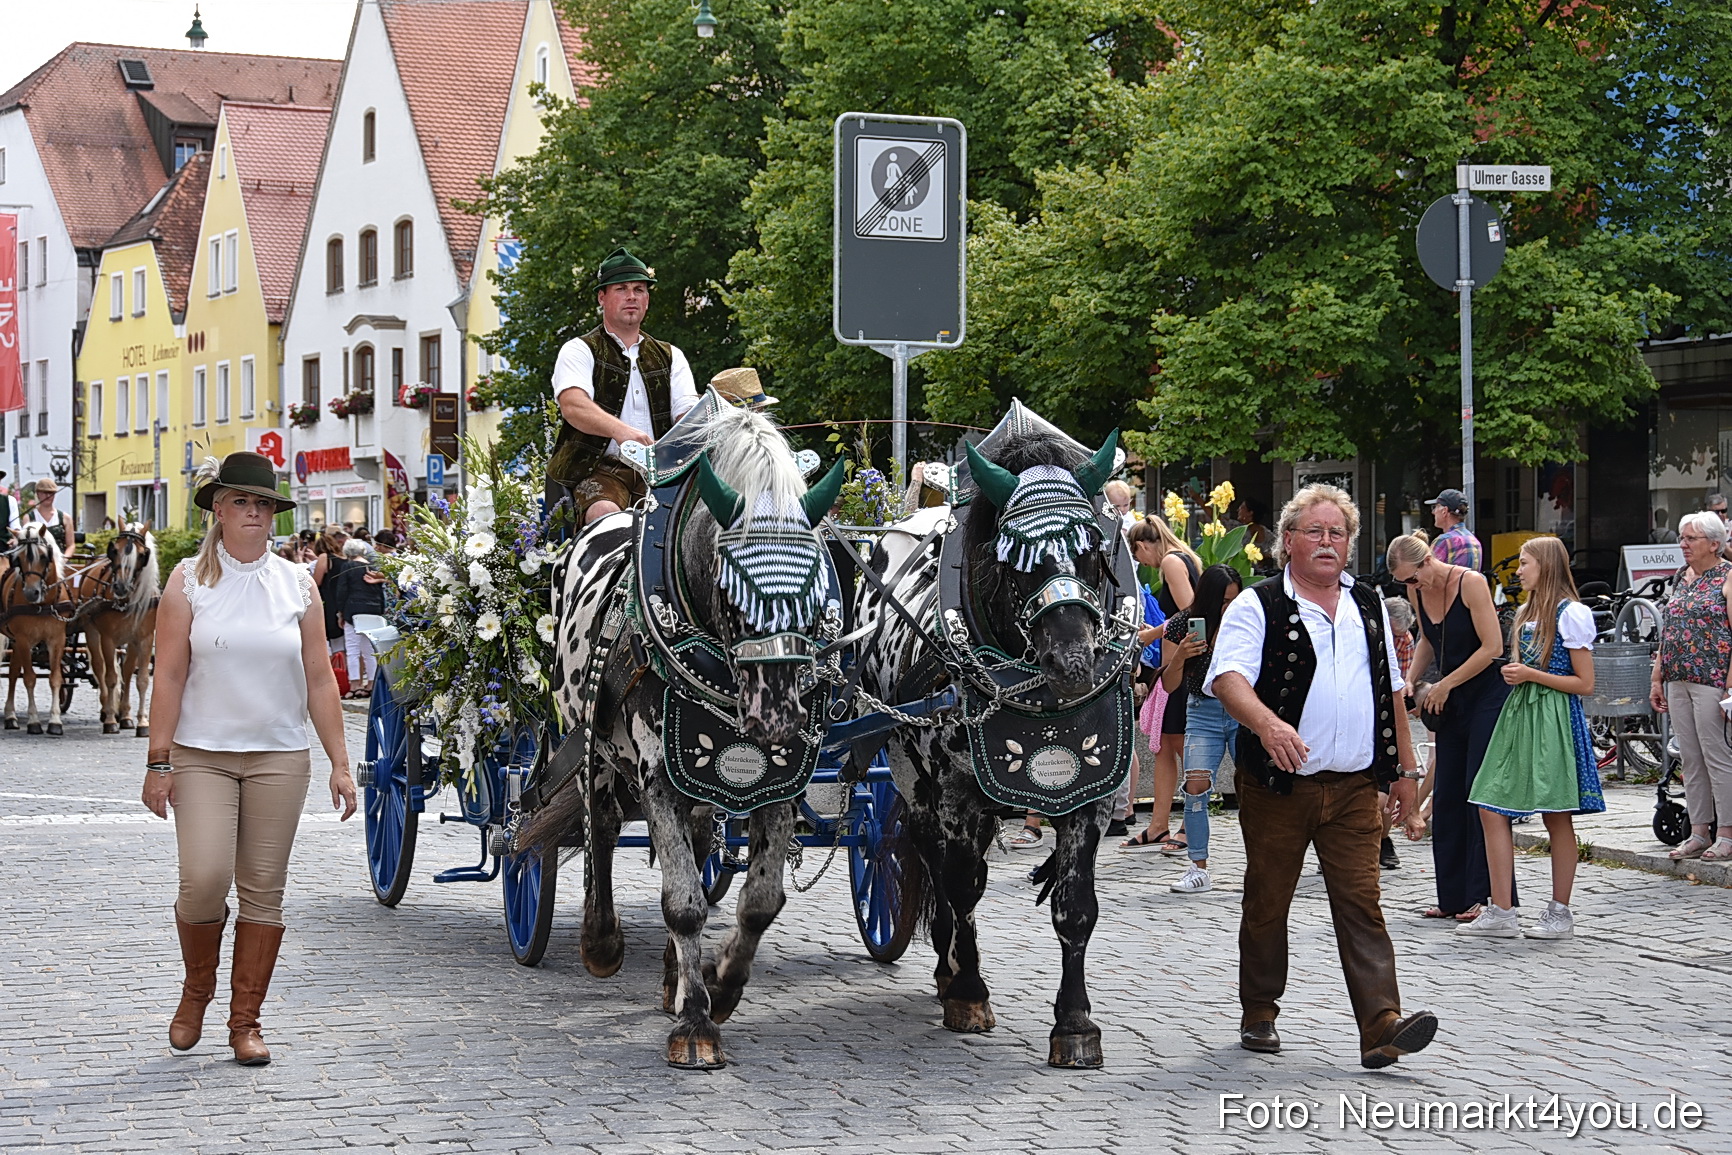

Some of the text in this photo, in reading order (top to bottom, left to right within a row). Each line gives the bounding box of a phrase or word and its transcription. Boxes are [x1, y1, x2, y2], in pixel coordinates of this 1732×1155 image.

[1475, 170, 1545, 185] Ulmer Gasse
[879, 216, 923, 233] ZONE
[122, 345, 147, 369] HOTEL
[120, 459, 154, 476] Restaurant
[386, 468, 406, 482] EIS
[725, 755, 760, 764] Holzrückerei
[1035, 758, 1072, 767] Holzrückerei
[724, 765, 757, 775] Weismann
[1037, 769, 1071, 778] Weismann
